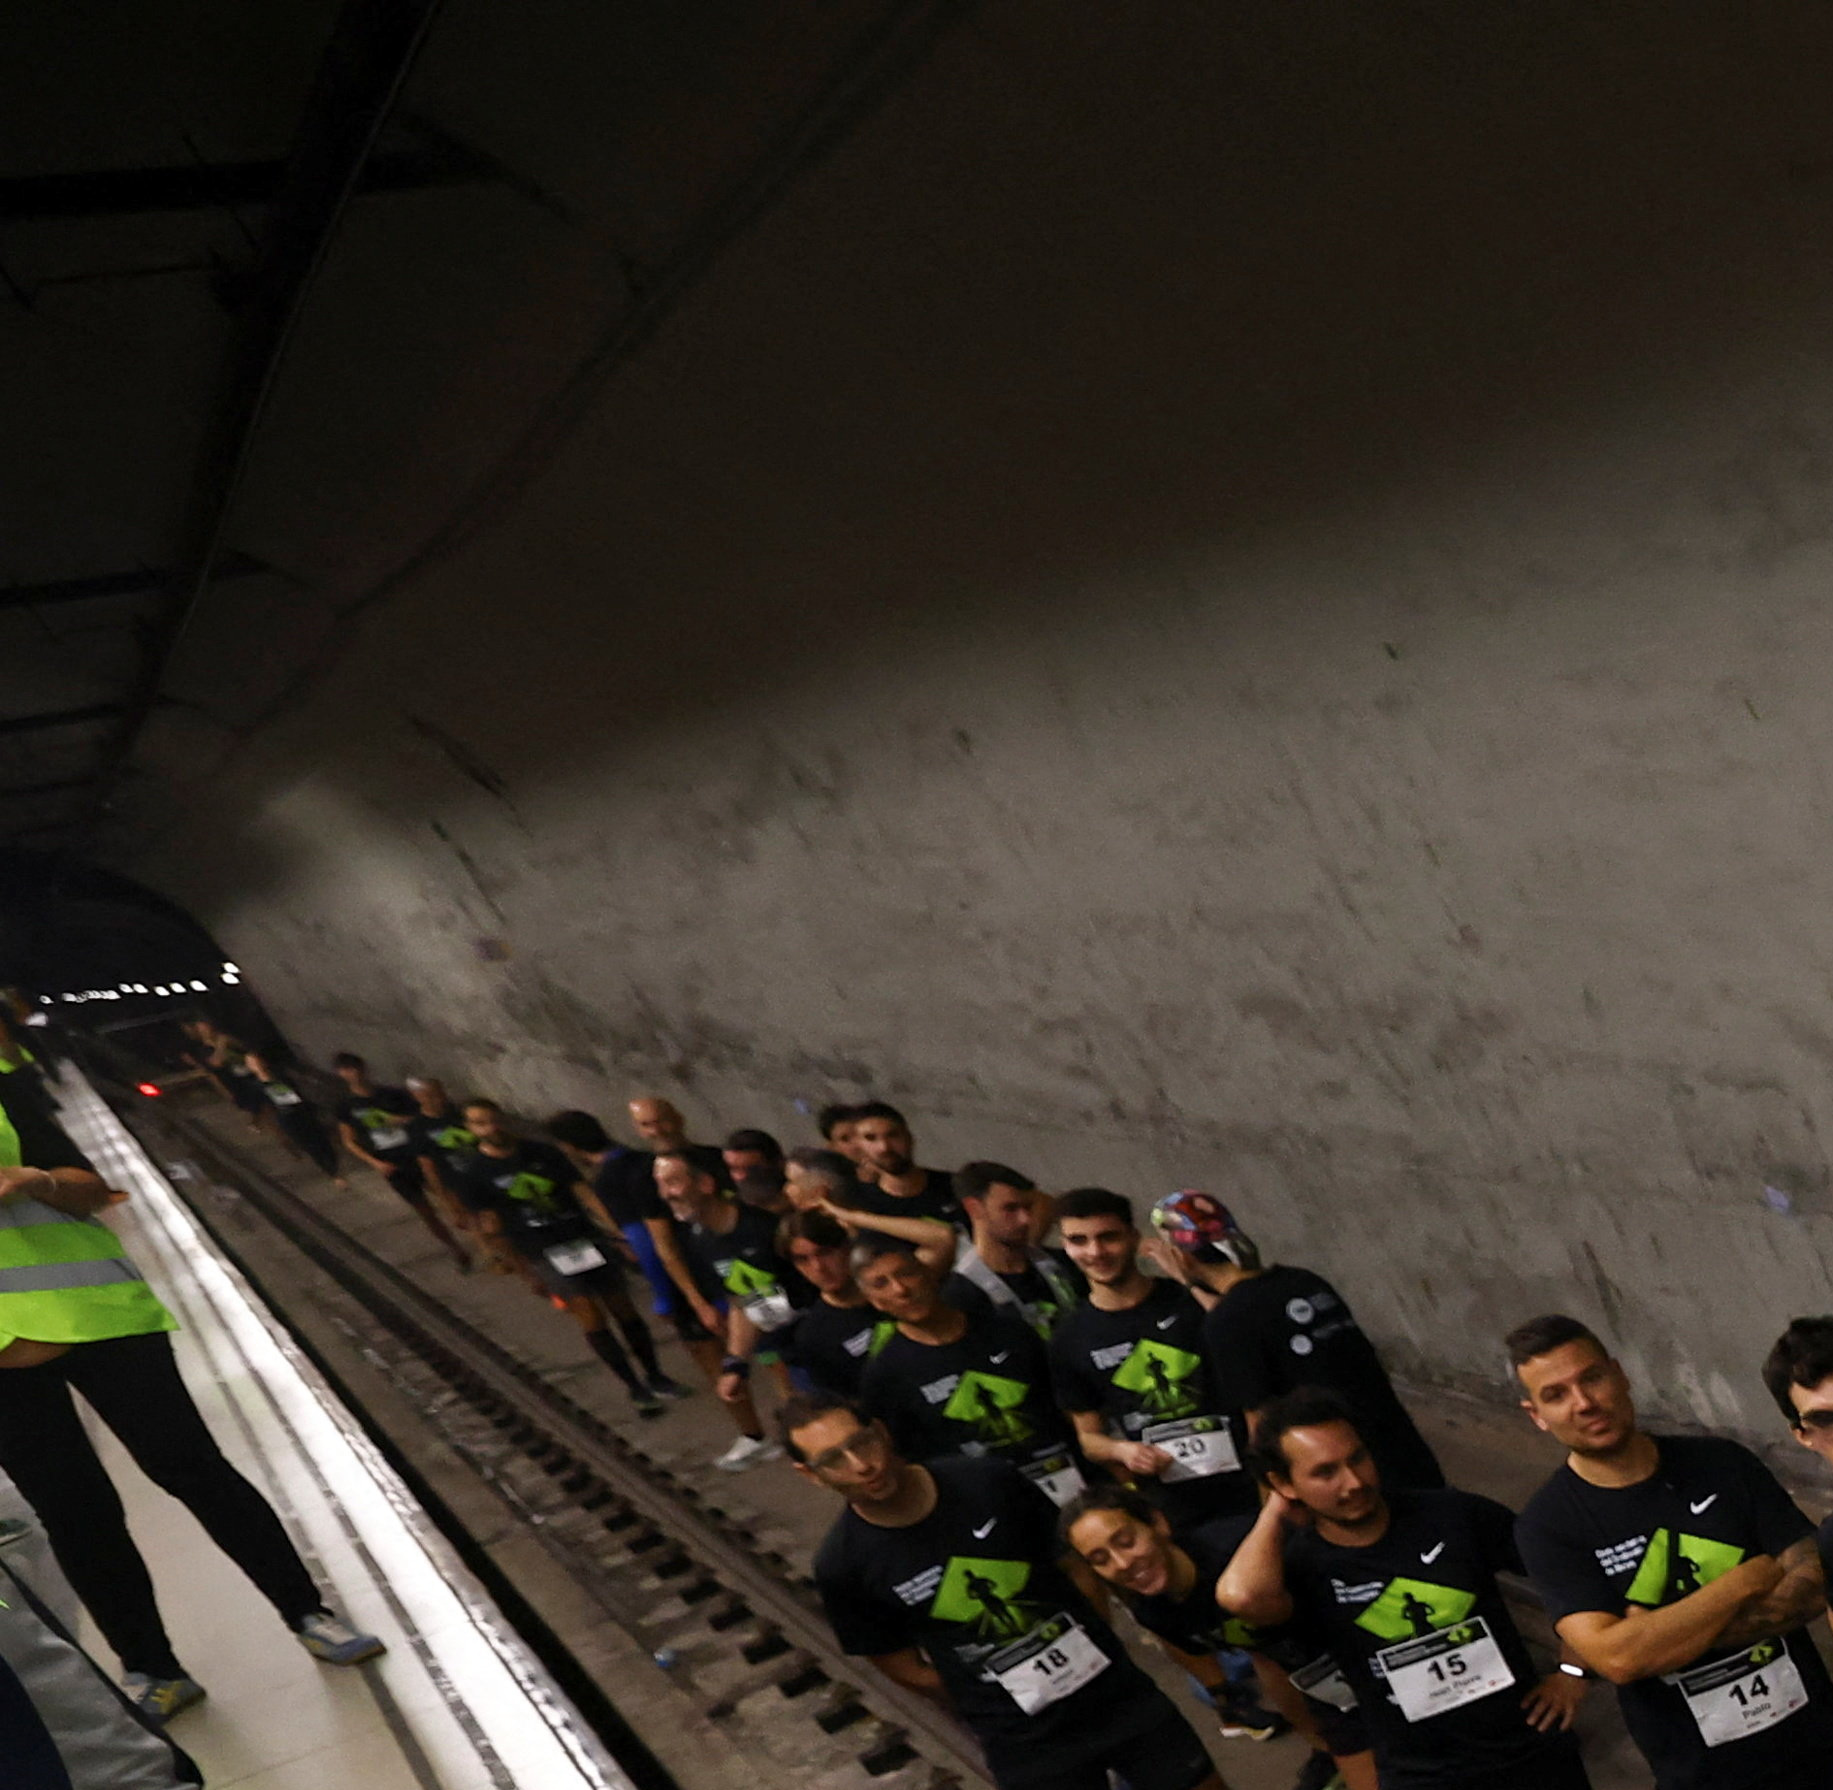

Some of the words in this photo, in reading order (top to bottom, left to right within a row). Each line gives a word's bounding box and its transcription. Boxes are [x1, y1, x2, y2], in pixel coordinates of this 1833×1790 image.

[1033, 1648, 1069, 1676] 18
[1427, 1652, 1467, 1682] 15
[1728, 1674, 1770, 1707] 14
